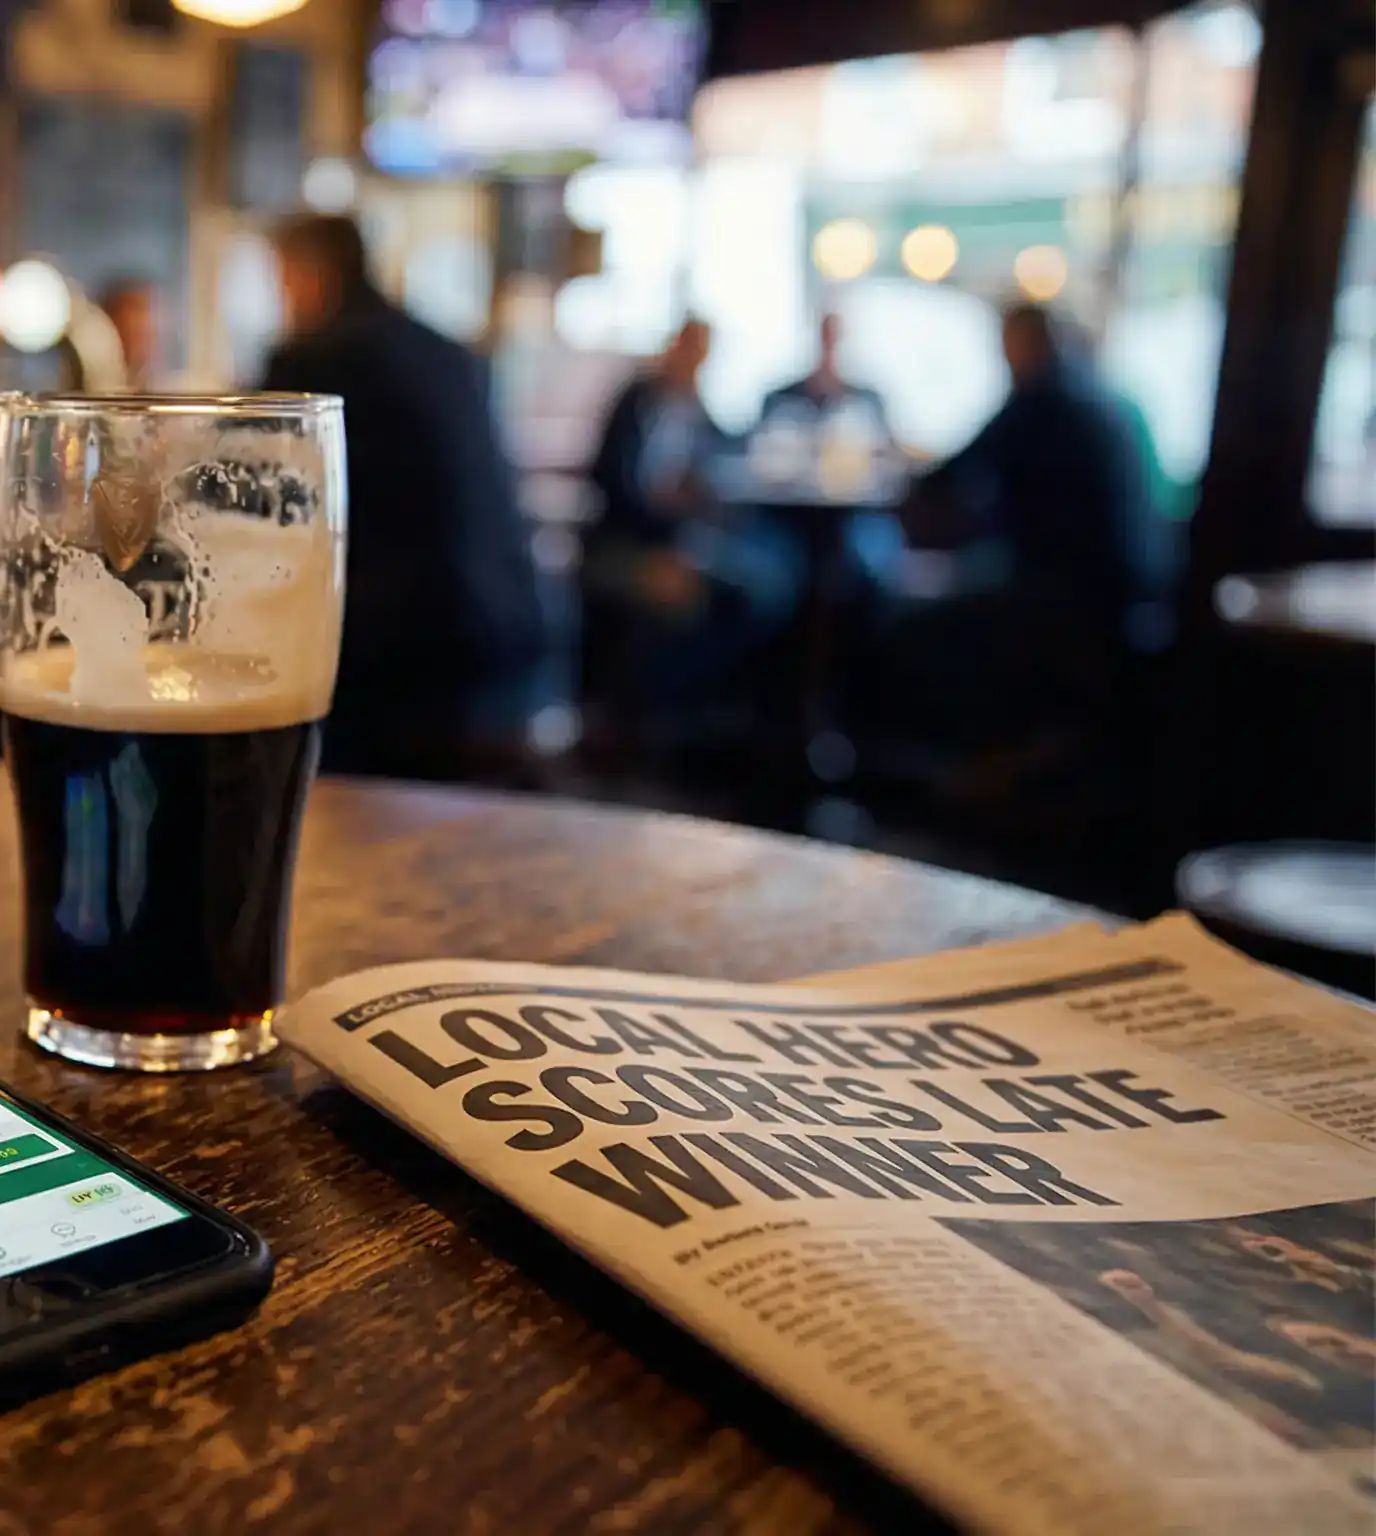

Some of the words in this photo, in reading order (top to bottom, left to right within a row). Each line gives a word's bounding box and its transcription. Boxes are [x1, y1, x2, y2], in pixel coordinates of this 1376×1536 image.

[348, 989, 431, 1024] LOCAL
[367, 1005, 764, 1089] LOCAL
[729, 1019, 1041, 1070] HERO
[462, 1064, 943, 1152] SCORES
[909, 1069, 1228, 1133] LATE
[550, 1132, 1124, 1229] WINNER
